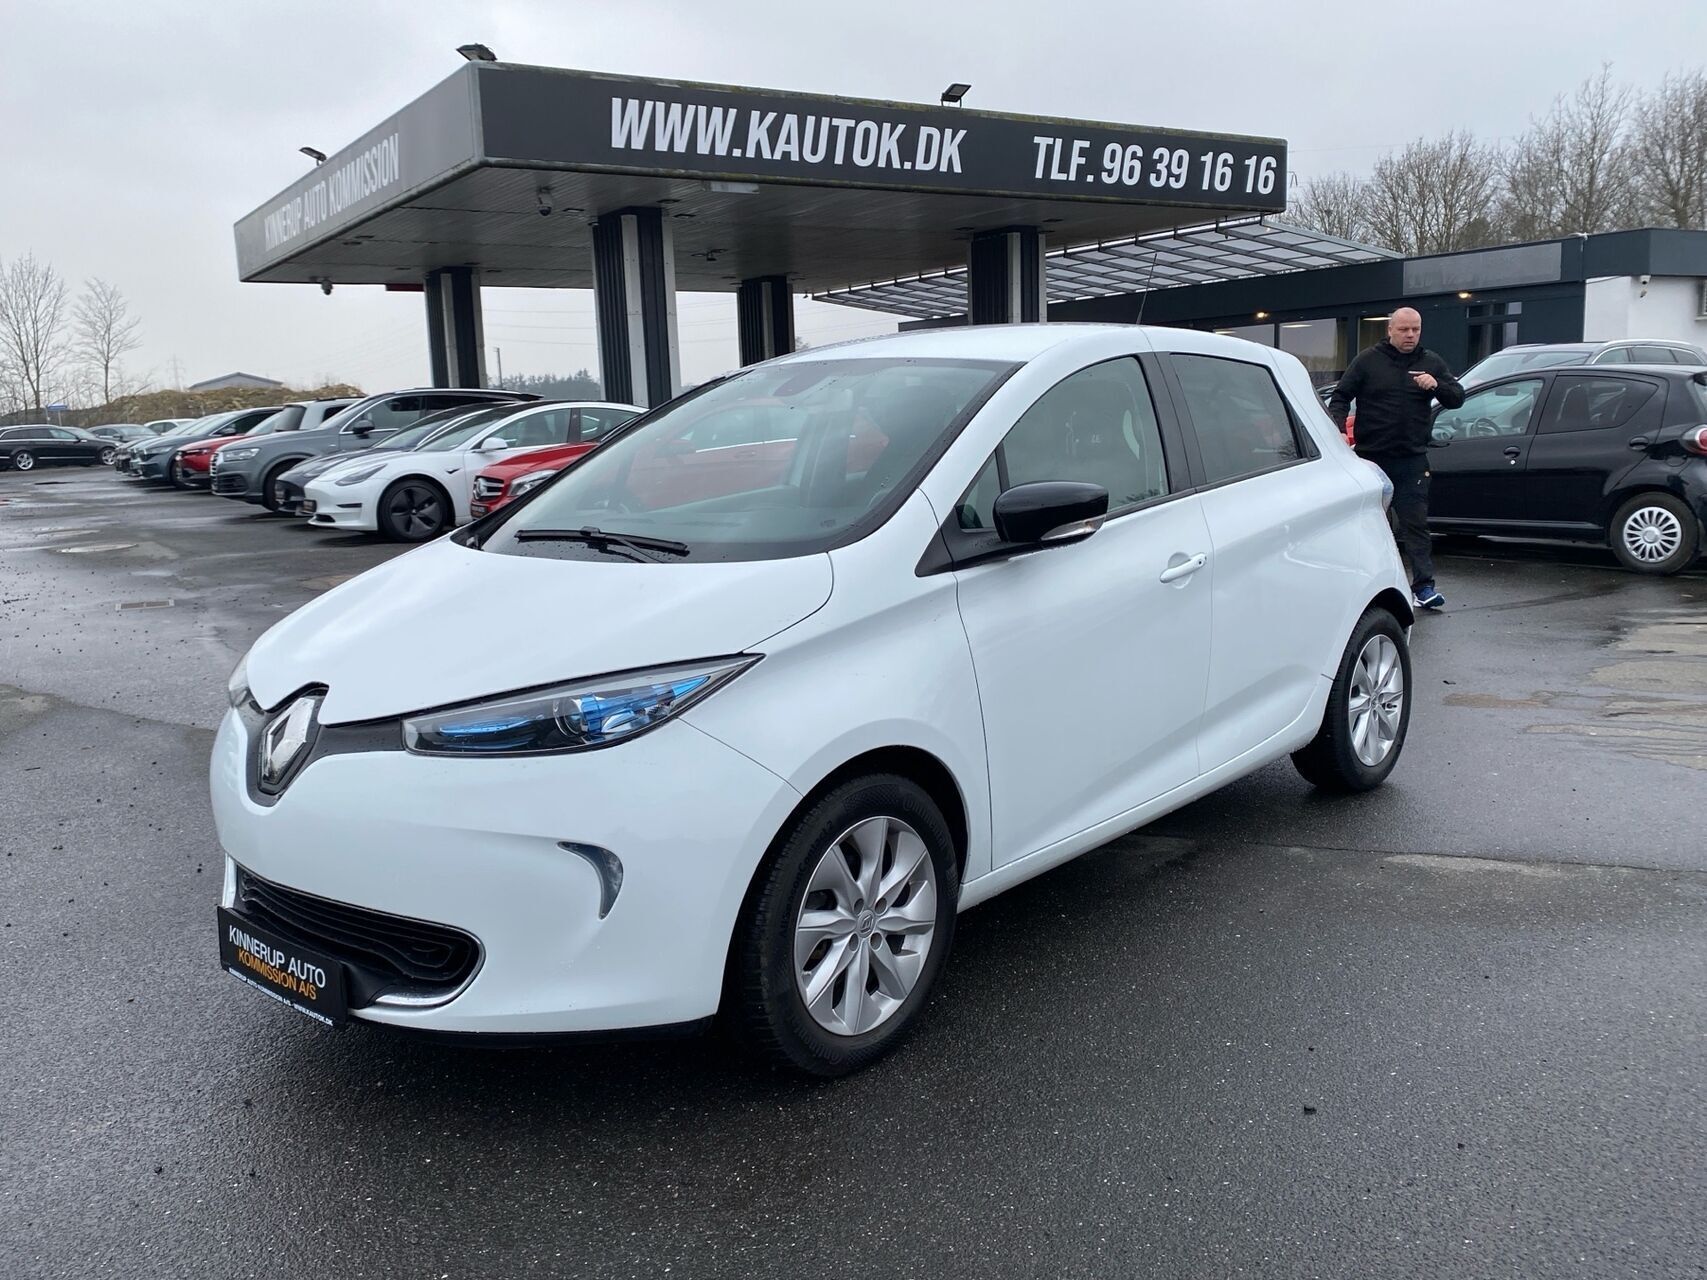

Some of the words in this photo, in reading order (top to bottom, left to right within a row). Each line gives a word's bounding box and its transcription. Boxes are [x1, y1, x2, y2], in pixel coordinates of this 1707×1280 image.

[610, 97, 968, 174] WWW.KAUTOK.DK
[1033, 135, 1094, 183] TLF.
[1101, 142, 1144, 187] 96
[1149, 147, 1190, 190] 39
[1200, 151, 1235, 192] 16
[1244, 155, 1277, 195] 16
[264, 197, 302, 251] KINNERUP
[304, 180, 328, 231] AUTO
[328, 132, 399, 217] KOMMISSION
[229, 925, 285, 969] KINNERUP
[288, 957, 326, 989] AUTO
[238, 949, 297, 991] KOMMISSION
[298, 980, 317, 1000] A/S
